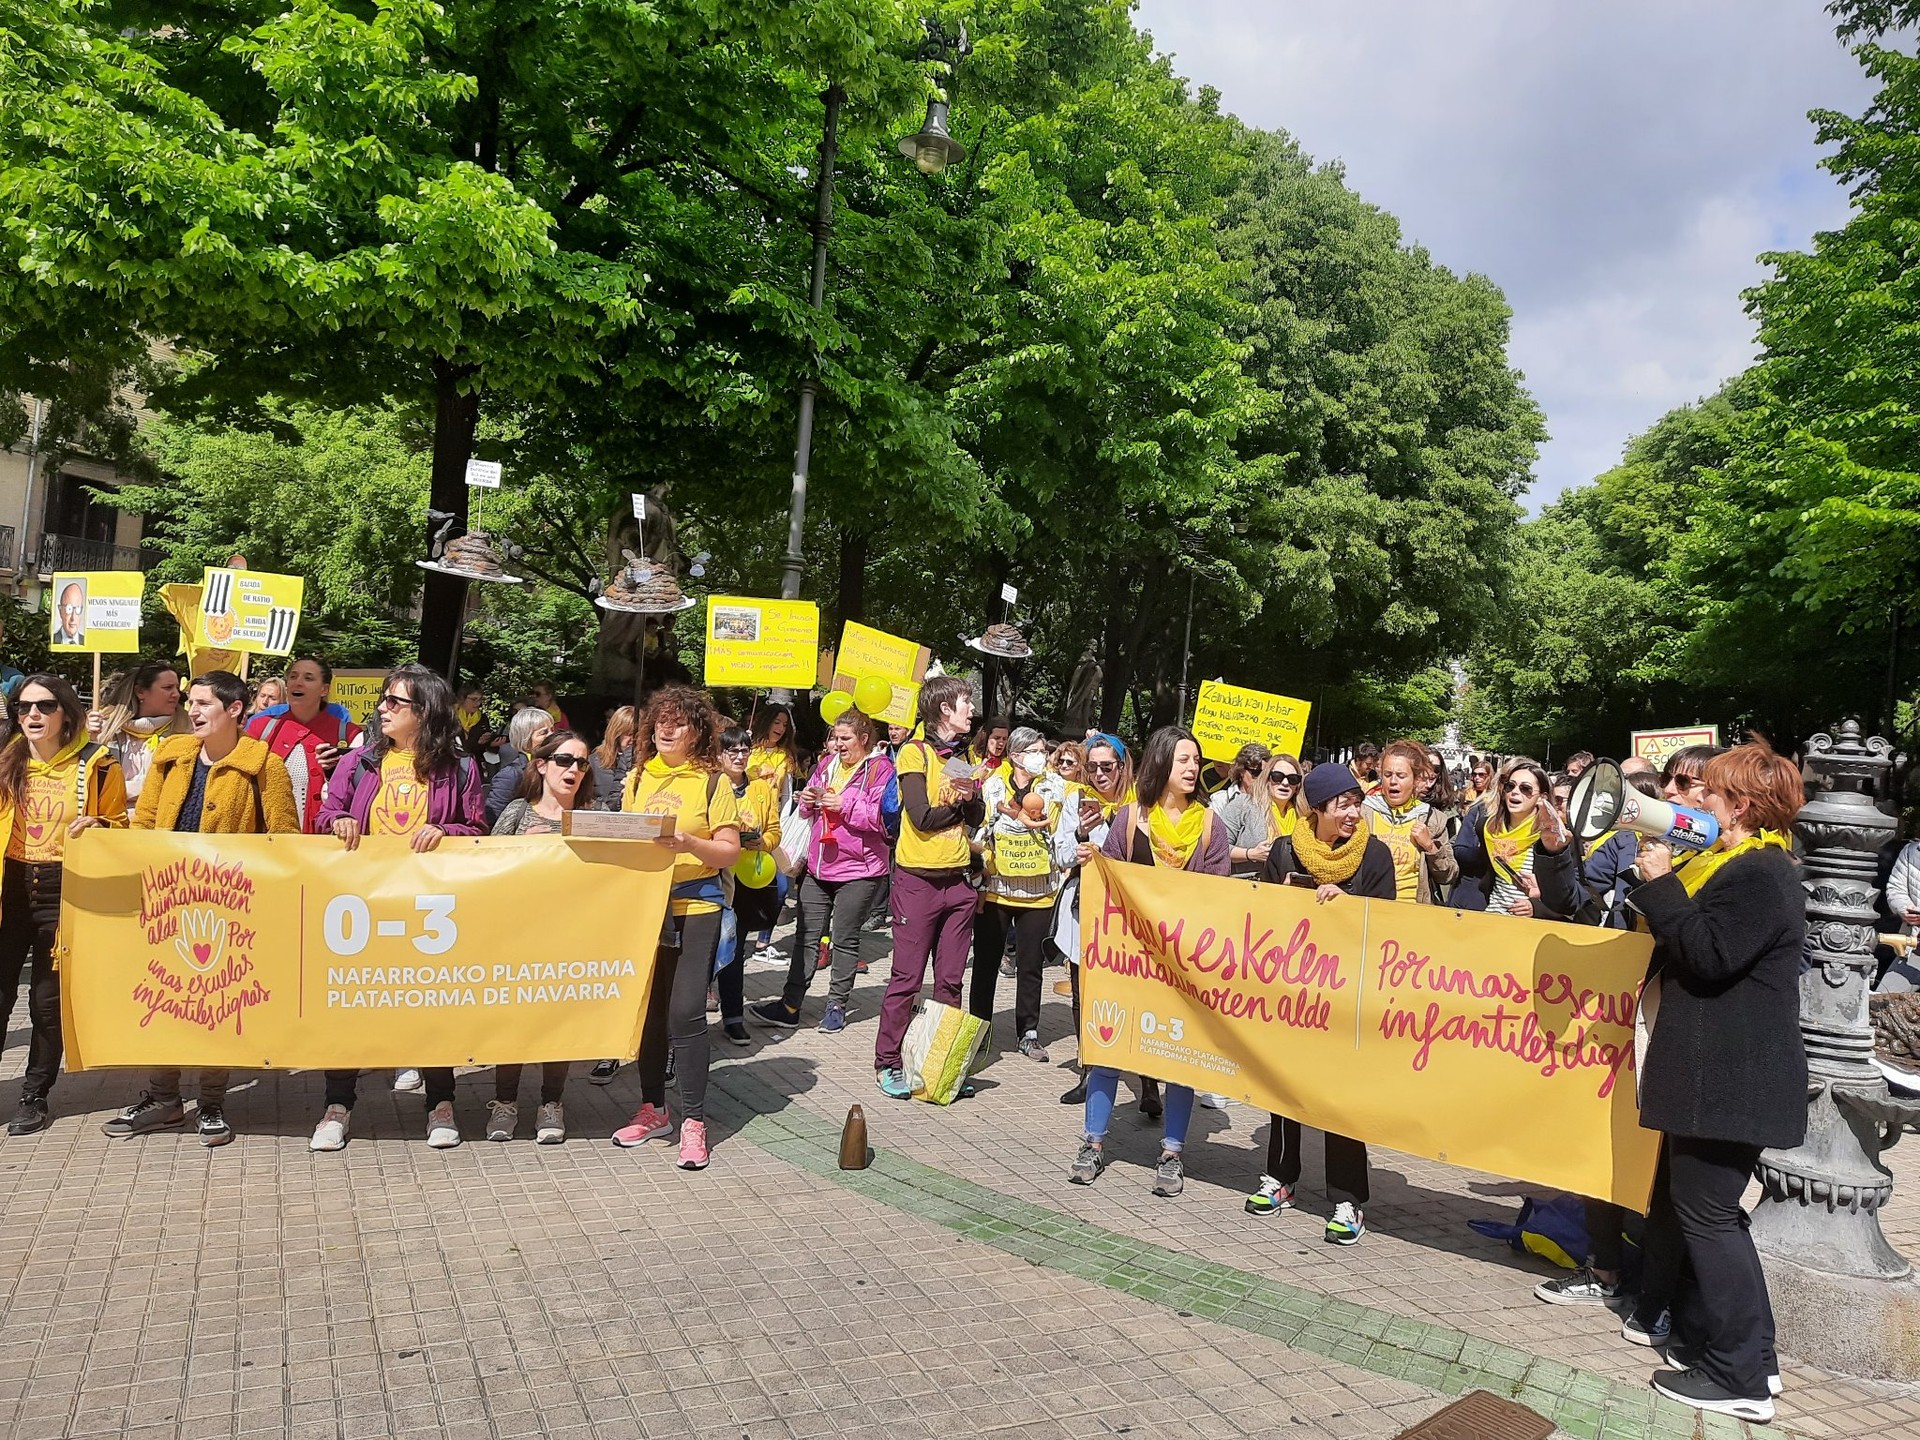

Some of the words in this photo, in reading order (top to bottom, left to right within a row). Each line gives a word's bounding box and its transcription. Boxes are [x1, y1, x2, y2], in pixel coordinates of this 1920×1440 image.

[87, 598, 108, 606] MENOS
[243, 594, 250, 602] DE
[252, 595, 271, 604] RATIO
[768, 608, 782, 620] Se
[233, 628, 241, 637] DE
[242, 630, 266, 638] SUELDO
[336, 682, 368, 696] RATIOS
[1265, 699, 1296, 716] behar
[1662, 736, 1686, 748] SOS
[1000, 849, 1027, 858] TENGO
[1034, 849, 1044, 857] MI
[1009, 861, 1037, 869] CARGO
[141, 857, 187, 895] Haur
[192, 853, 255, 895] eskolen
[139, 882, 251, 929] duintasunaren
[147, 915, 179, 945] alde
[227, 920, 257, 950] Por
[323, 893, 459, 956] 0-3
[1187, 912, 1347, 990] eskolen
[147, 958, 184, 992] unas
[187, 953, 254, 997] escuelas
[327, 965, 486, 986] NAFARROAKO
[492, 959, 636, 982] PLATAFORMA
[1085, 916, 1273, 1022] duintasunaren
[1277, 987, 1331, 1032] alde
[1378, 939, 1430, 991] Por
[1428, 966, 1531, 1004] unas
[132, 978, 215, 1031] infantiles
[216, 979, 271, 1035] dignas
[327, 987, 477, 1008] PLATAFORMA
[482, 987, 510, 1006] DE
[516, 982, 621, 1004] NAVARRA
[1140, 1011, 1184, 1041] 0-3
[1378, 997, 1560, 1077] infantiles
[1139, 1045, 1188, 1063] PLATAFORMA
[1189, 1056, 1200, 1067] DE
[1200, 1060, 1238, 1077] NAVARRA
[1140, 1036, 1192, 1056] NAFARROAKO
[1193, 1049, 1242, 1071] PLATAFORMA
